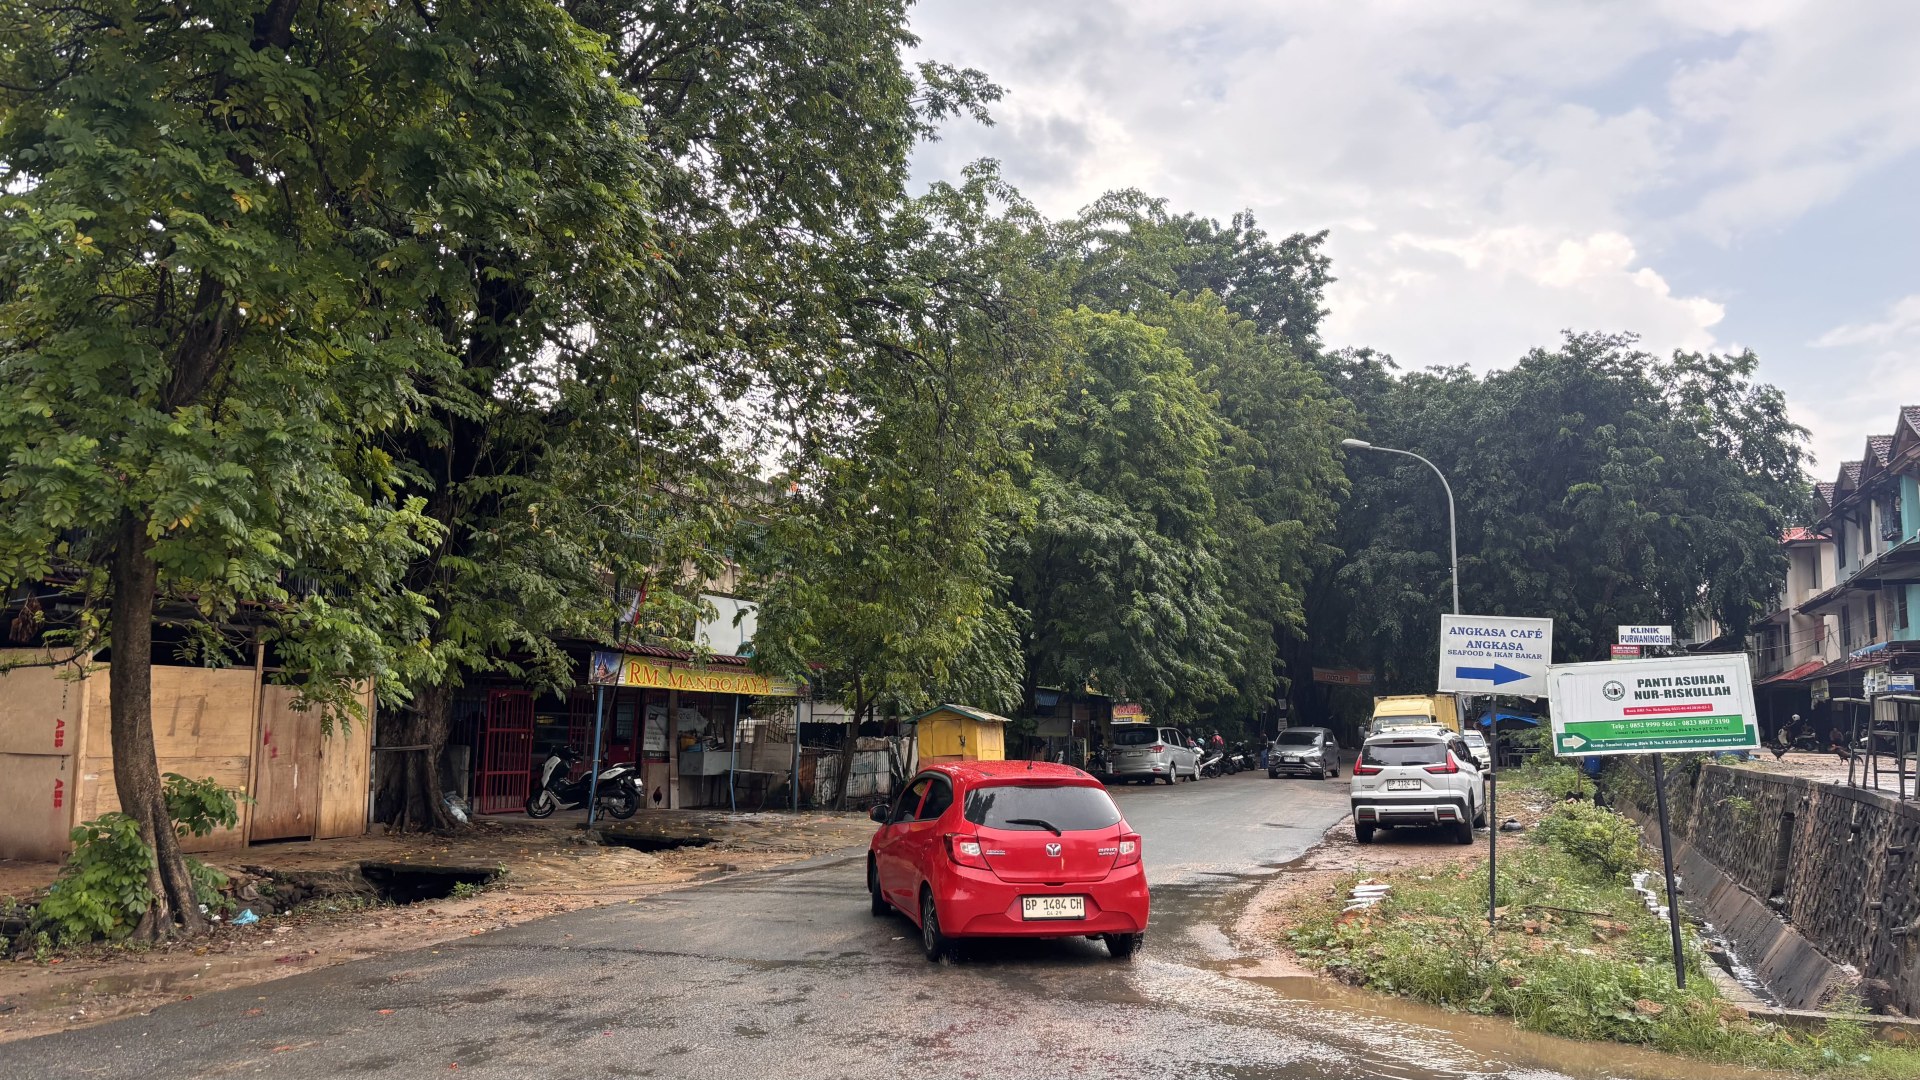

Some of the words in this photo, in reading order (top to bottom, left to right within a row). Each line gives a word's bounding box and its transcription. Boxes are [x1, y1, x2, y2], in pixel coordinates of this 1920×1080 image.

[1449, 626, 1506, 637] ANGKASA
[1510, 628, 1543, 639] CAFÉ
[1620, 635, 1670, 643] PURWANINGSIH
[1466, 640, 1524, 651] ANGKASA
[1447, 649, 1484, 657] SEAFOOD
[1515, 652, 1542, 660] BAKAR
[628, 660, 662, 686] RM.
[668, 671, 732, 691] MANDO
[735, 674, 770, 694] JAYA
[1637, 677, 1672, 688] PANTI
[1675, 675, 1725, 686] ASUHAN
[1634, 686, 1731, 700] NUR-RISKULLAH
[54, 718, 66, 748] ABB
[53, 778, 65, 809] ABB
[1025, 899, 1037, 911] BP
[1043, 899, 1067, 910] 1484
[1070, 898, 1082, 909] CH
